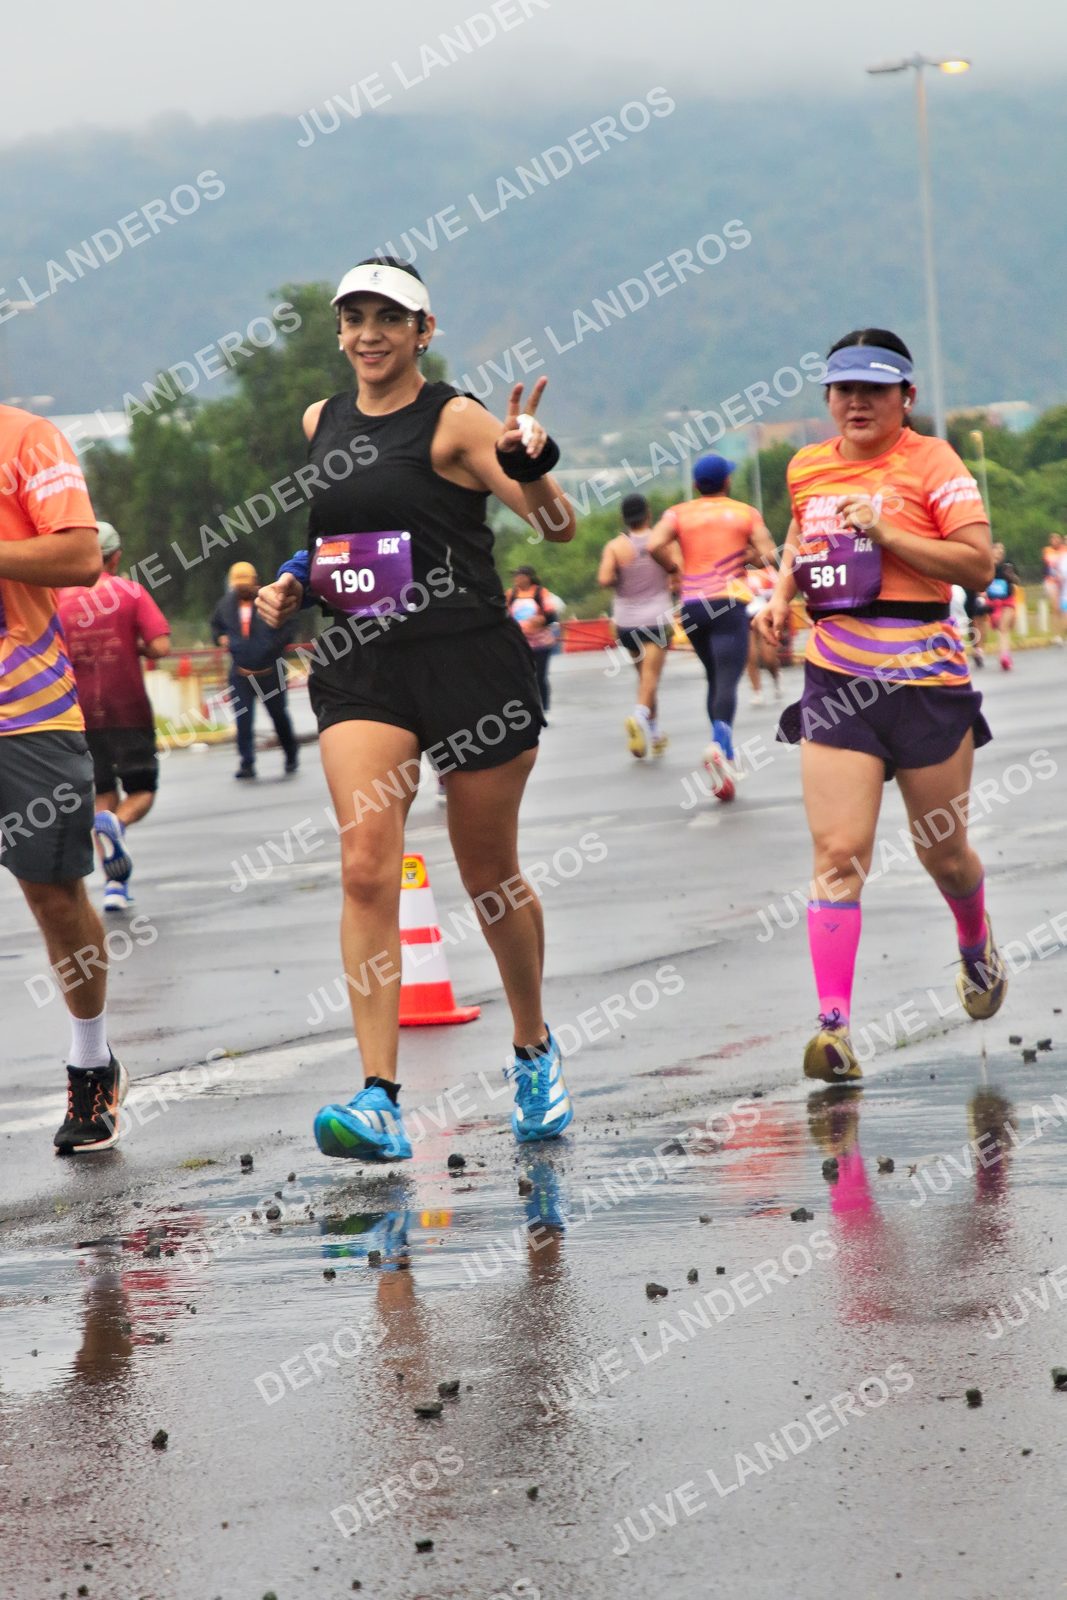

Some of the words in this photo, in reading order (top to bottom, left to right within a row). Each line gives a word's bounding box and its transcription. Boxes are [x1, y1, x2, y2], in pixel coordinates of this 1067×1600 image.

[377, 537, 401, 555] 15K
[853, 538, 873, 553] 15K
[330, 568, 376, 594] 190
[810, 564, 847, 589] 581
